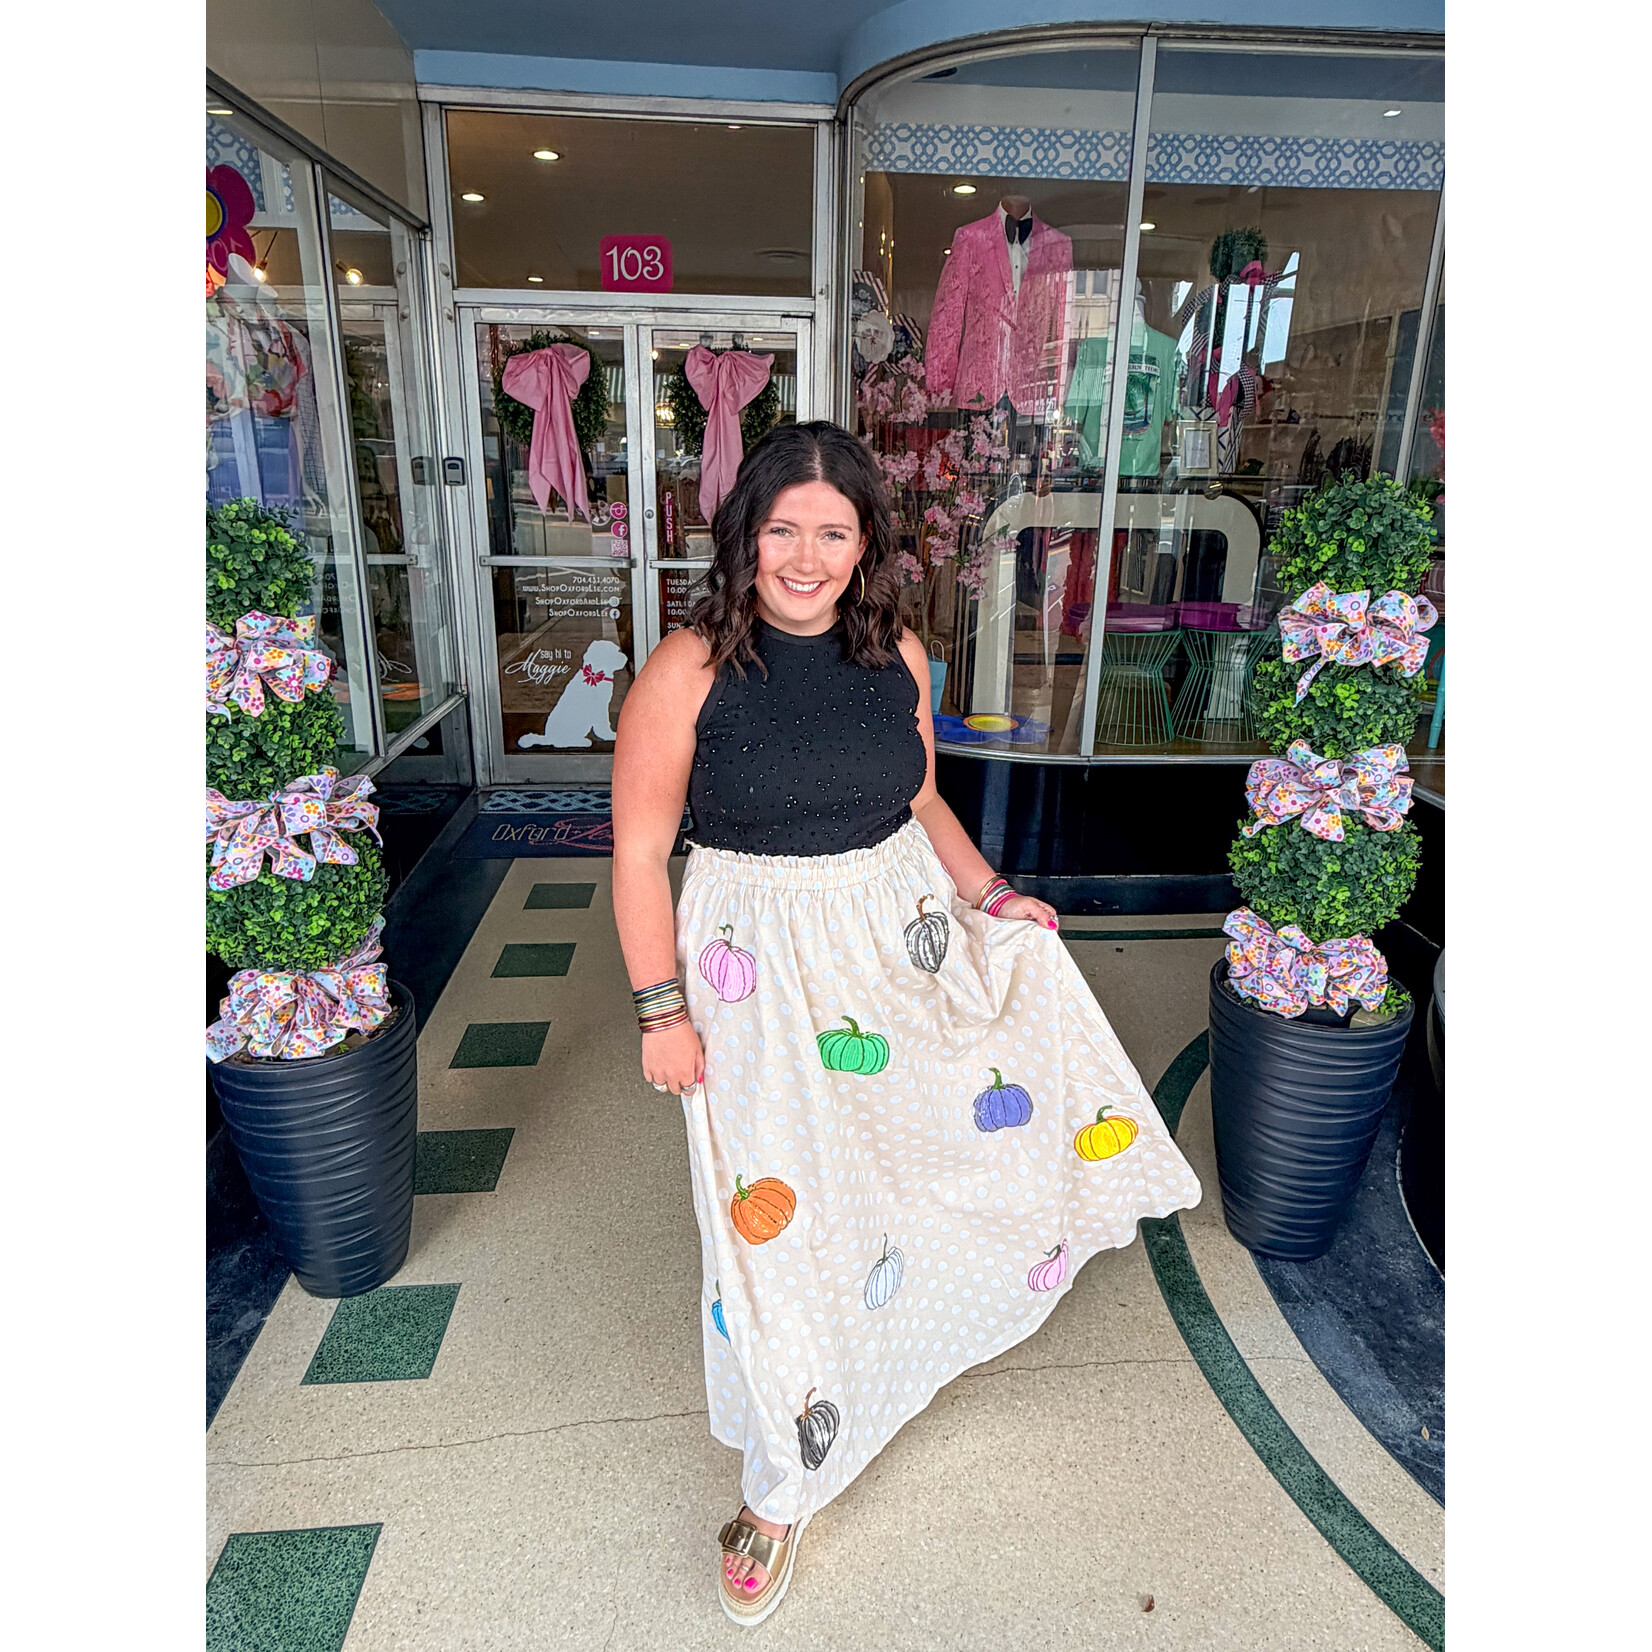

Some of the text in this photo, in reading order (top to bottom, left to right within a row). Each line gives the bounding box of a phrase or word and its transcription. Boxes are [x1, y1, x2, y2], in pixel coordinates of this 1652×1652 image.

[605, 245, 664, 281] 103
[665, 491, 674, 543] PUSH
[504, 648, 571, 685] Maggie
[540, 648, 572, 661] say hi to
[491, 823, 572, 841] Oxford
